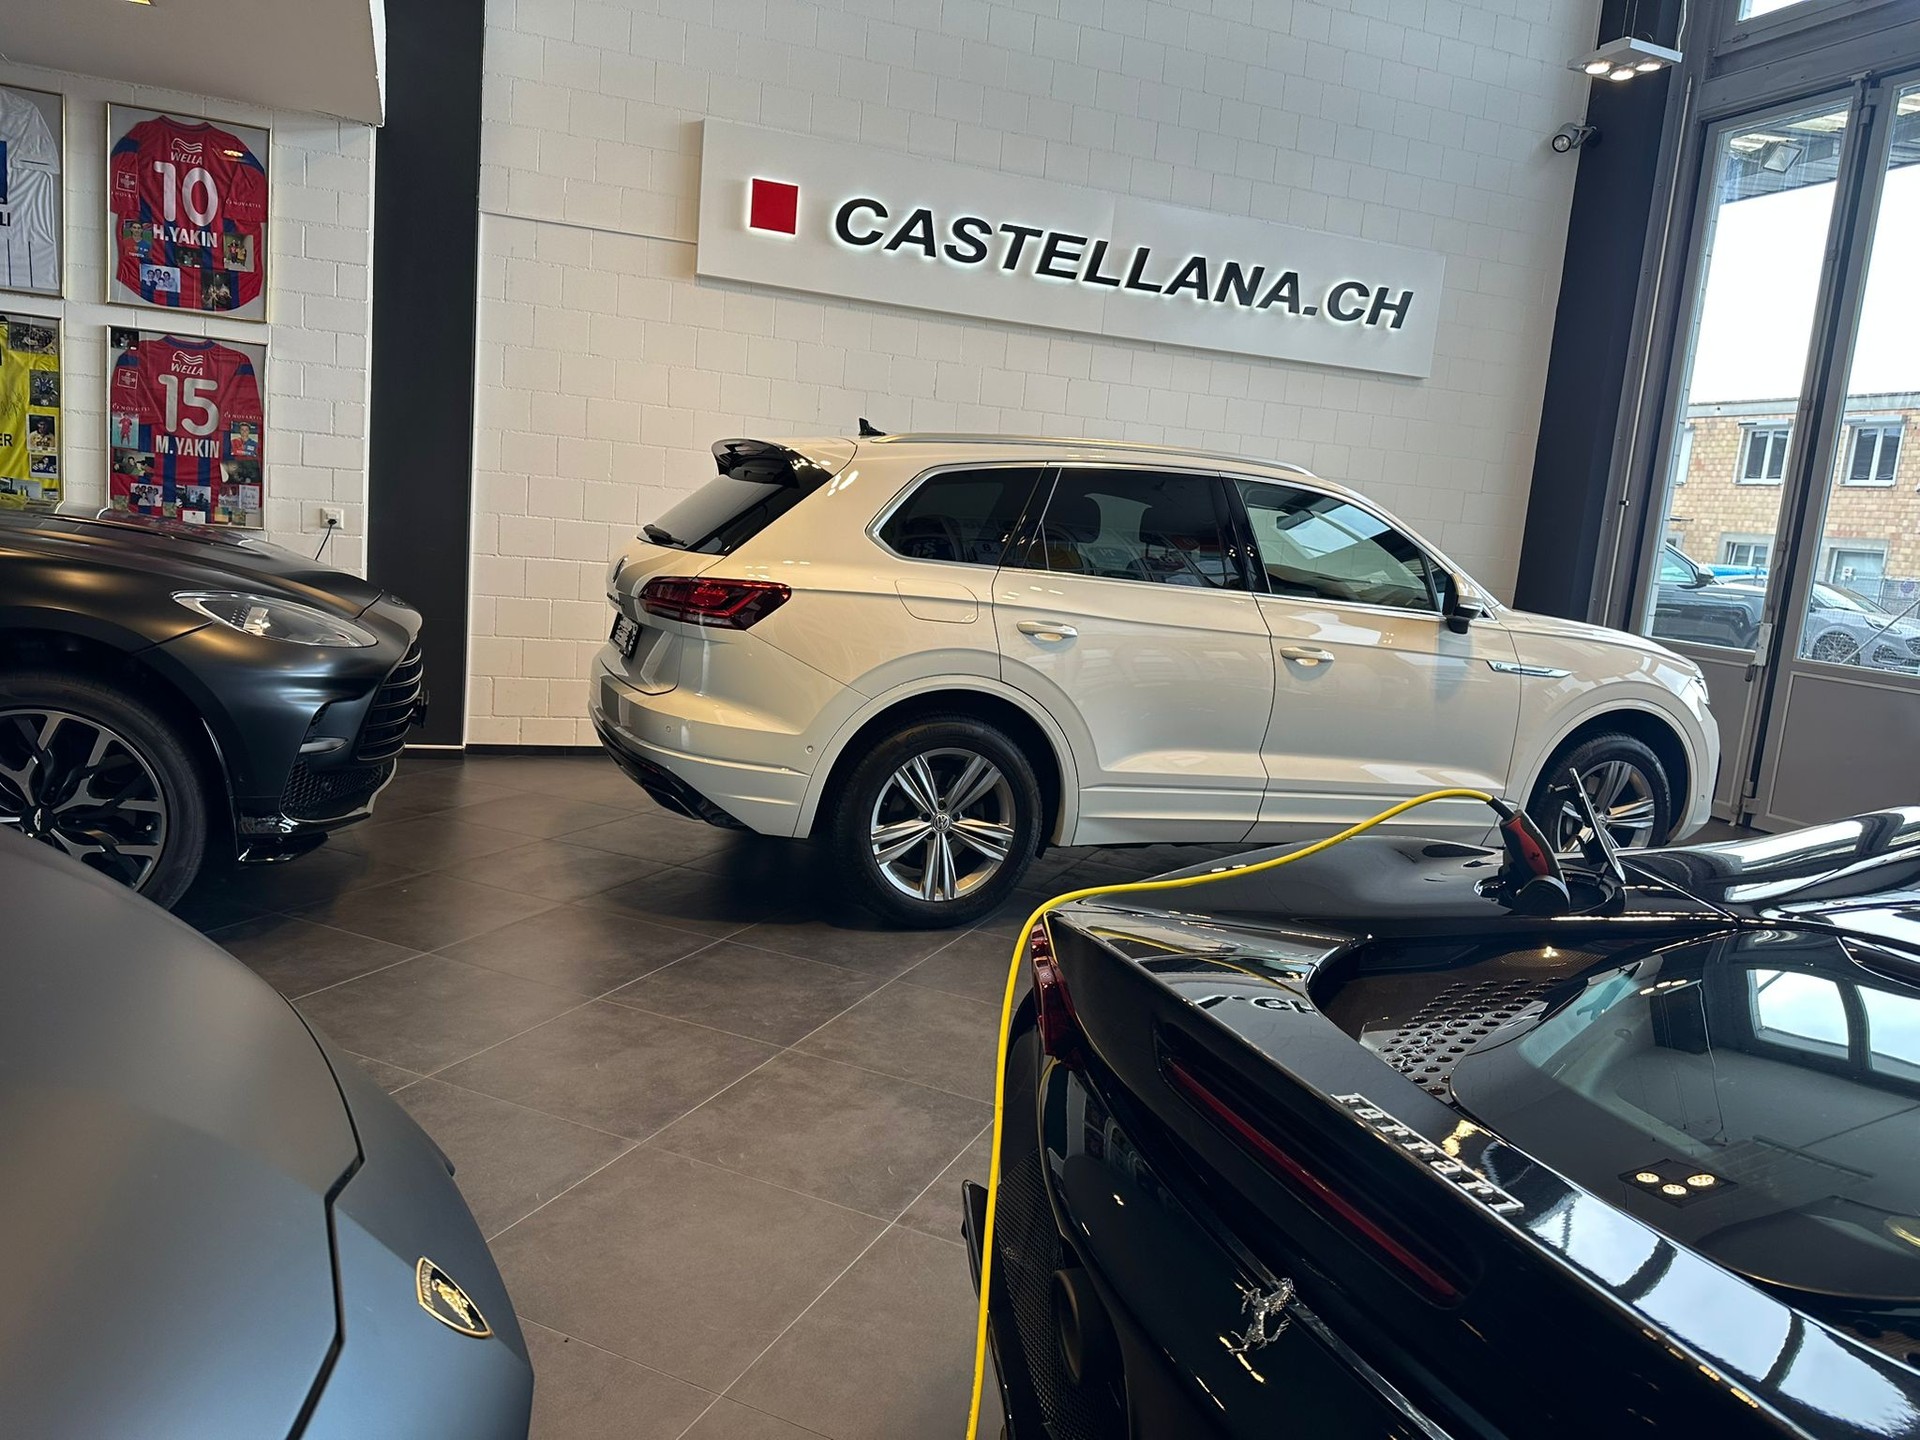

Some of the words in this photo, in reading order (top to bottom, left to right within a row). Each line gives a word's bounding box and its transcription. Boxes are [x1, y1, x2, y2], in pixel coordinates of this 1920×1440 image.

[170, 151, 203, 165] WELLA
[154, 161, 218, 227] 10
[153, 223, 218, 248] H.YAKIN
[834, 197, 1414, 331] CASTELLANA.CH
[171, 362, 204, 376] WELLA
[158, 374, 219, 436] 15
[155, 435, 219, 459] M.YAKIN
